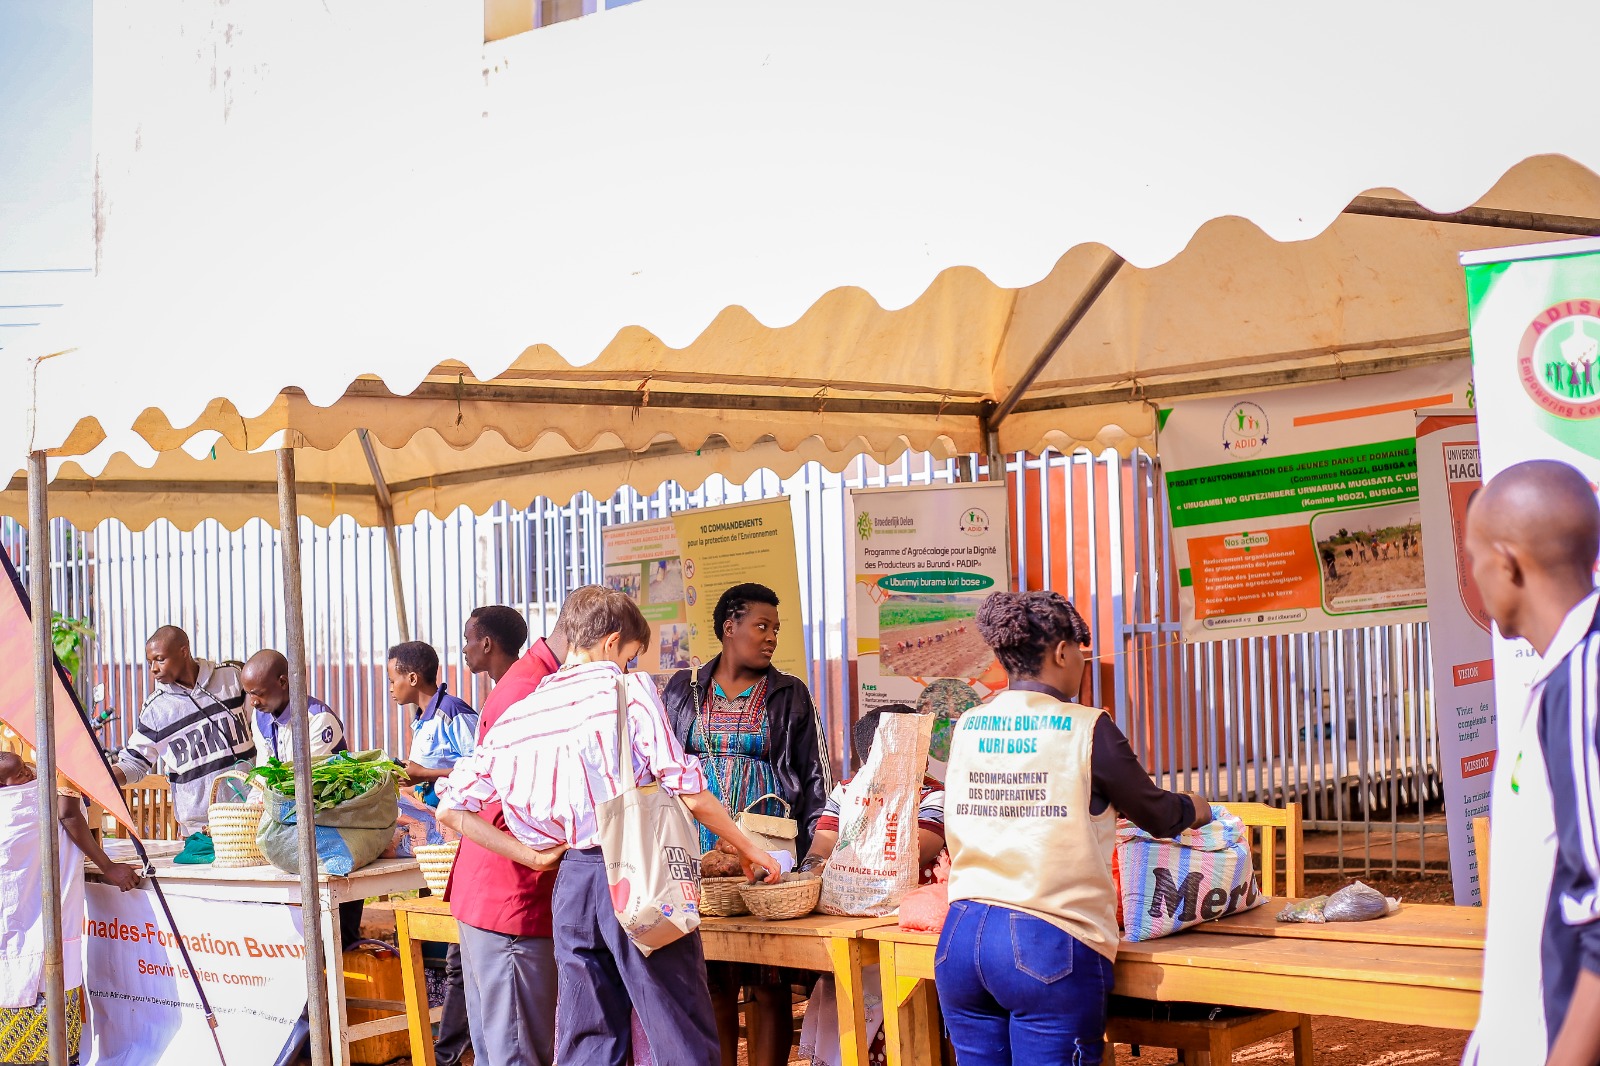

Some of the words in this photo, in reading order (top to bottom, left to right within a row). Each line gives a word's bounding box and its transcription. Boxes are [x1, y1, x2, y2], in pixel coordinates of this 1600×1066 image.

[1532, 300, 1600, 336] ADIS
[1520, 356, 1574, 417] Empowering
[1235, 438, 1257, 449] ADID
[1170, 478, 1198, 488] PROJET
[1200, 467, 1276, 484] D'AUTONOMISATION
[1278, 464, 1294, 474] DES
[1296, 460, 1329, 471] JEUNES
[1332, 456, 1354, 466] DANS
[1356, 454, 1366, 462] LE
[1370, 448, 1410, 460] DOMAINE
[1340, 466, 1370, 476] NGOZI,
[1372, 462, 1406, 472] BUSIGA
[1184, 498, 1223, 510] UMUGAMBI
[1224, 496, 1238, 504] WO
[1240, 488, 1296, 502] GUTEZIMBERE
[1298, 482, 1346, 495] URWARUKA
[1348, 476, 1394, 488] MUGISATA
[1302, 496, 1335, 508] (Komine
[1337, 492, 1368, 502] NGOZI,
[1369, 486, 1404, 498] BUSIGA
[700, 525, 708, 534] 10
[708, 517, 763, 532] COMMANDEMENTS
[874, 516, 900, 528] Broederlijk
[900, 515, 914, 526] Delen
[688, 539, 698, 548] pour
[699, 538, 704, 546] la
[704, 534, 730, 546] protection
[730, 534, 738, 542] de
[738, 529, 778, 541] l'Environnement
[1224, 539, 1240, 547] Nos
[1240, 535, 1269, 546] actions
[864, 547, 900, 558] Programme
[902, 546, 950, 558] d'Agroécologie
[950, 548, 966, 556] pour
[966, 546, 972, 555] la
[974, 545, 997, 556] Dignité
[1203, 556, 1243, 565] Renforcement
[1244, 550, 1296, 560] organisationnel
[864, 561, 876, 569] des
[877, 560, 916, 569] Producteurs
[926, 560, 950, 568] Burundi
[1216, 562, 1254, 572] groupements
[1255, 560, 1266, 568] des
[1266, 559, 1286, 568] jeunes
[890, 578, 920, 588] Uburimyi
[920, 578, 946, 587] burama
[948, 578, 960, 587] kuri
[960, 577, 980, 586] bose
[1205, 576, 1234, 584] Formation
[1248, 572, 1270, 580] jeunes
[1215, 582, 1244, 591] pratiques
[1238, 594, 1260, 602] jeunes
[1458, 666, 1479, 680] VISION
[862, 682, 877, 690] Axes
[1456, 706, 1473, 716] Vivier
[1480, 702, 1488, 712] des
[1014, 716, 1072, 731] BURAMA
[1458, 716, 1486, 730] compétents
[168, 711, 250, 768] BRKLN
[1458, 728, 1480, 742] intégral
[978, 738, 1004, 754] KURI
[1006, 738, 1038, 754] BOSE
[1464, 756, 1490, 773] MISSION
[969, 772, 1048, 784] ACCOMPAGNEMENT
[968, 788, 982, 800] DES
[984, 788, 1046, 801] COOPERATIVES
[1464, 794, 1472, 804] La
[956, 804, 969, 815] DES
[970, 804, 998, 817] JEUNES
[998, 806, 1068, 818] AGRICULTEURS
[1464, 804, 1490, 818] formation
[884, 812, 898, 862] SUPER
[848, 866, 872, 875] MAIZE
[874, 869, 898, 878] FLOUR
[138, 958, 174, 977] Servir
[177, 964, 189, 979] le
[90, 990, 108, 998] Institut
[110, 992, 132, 1000] Africain
